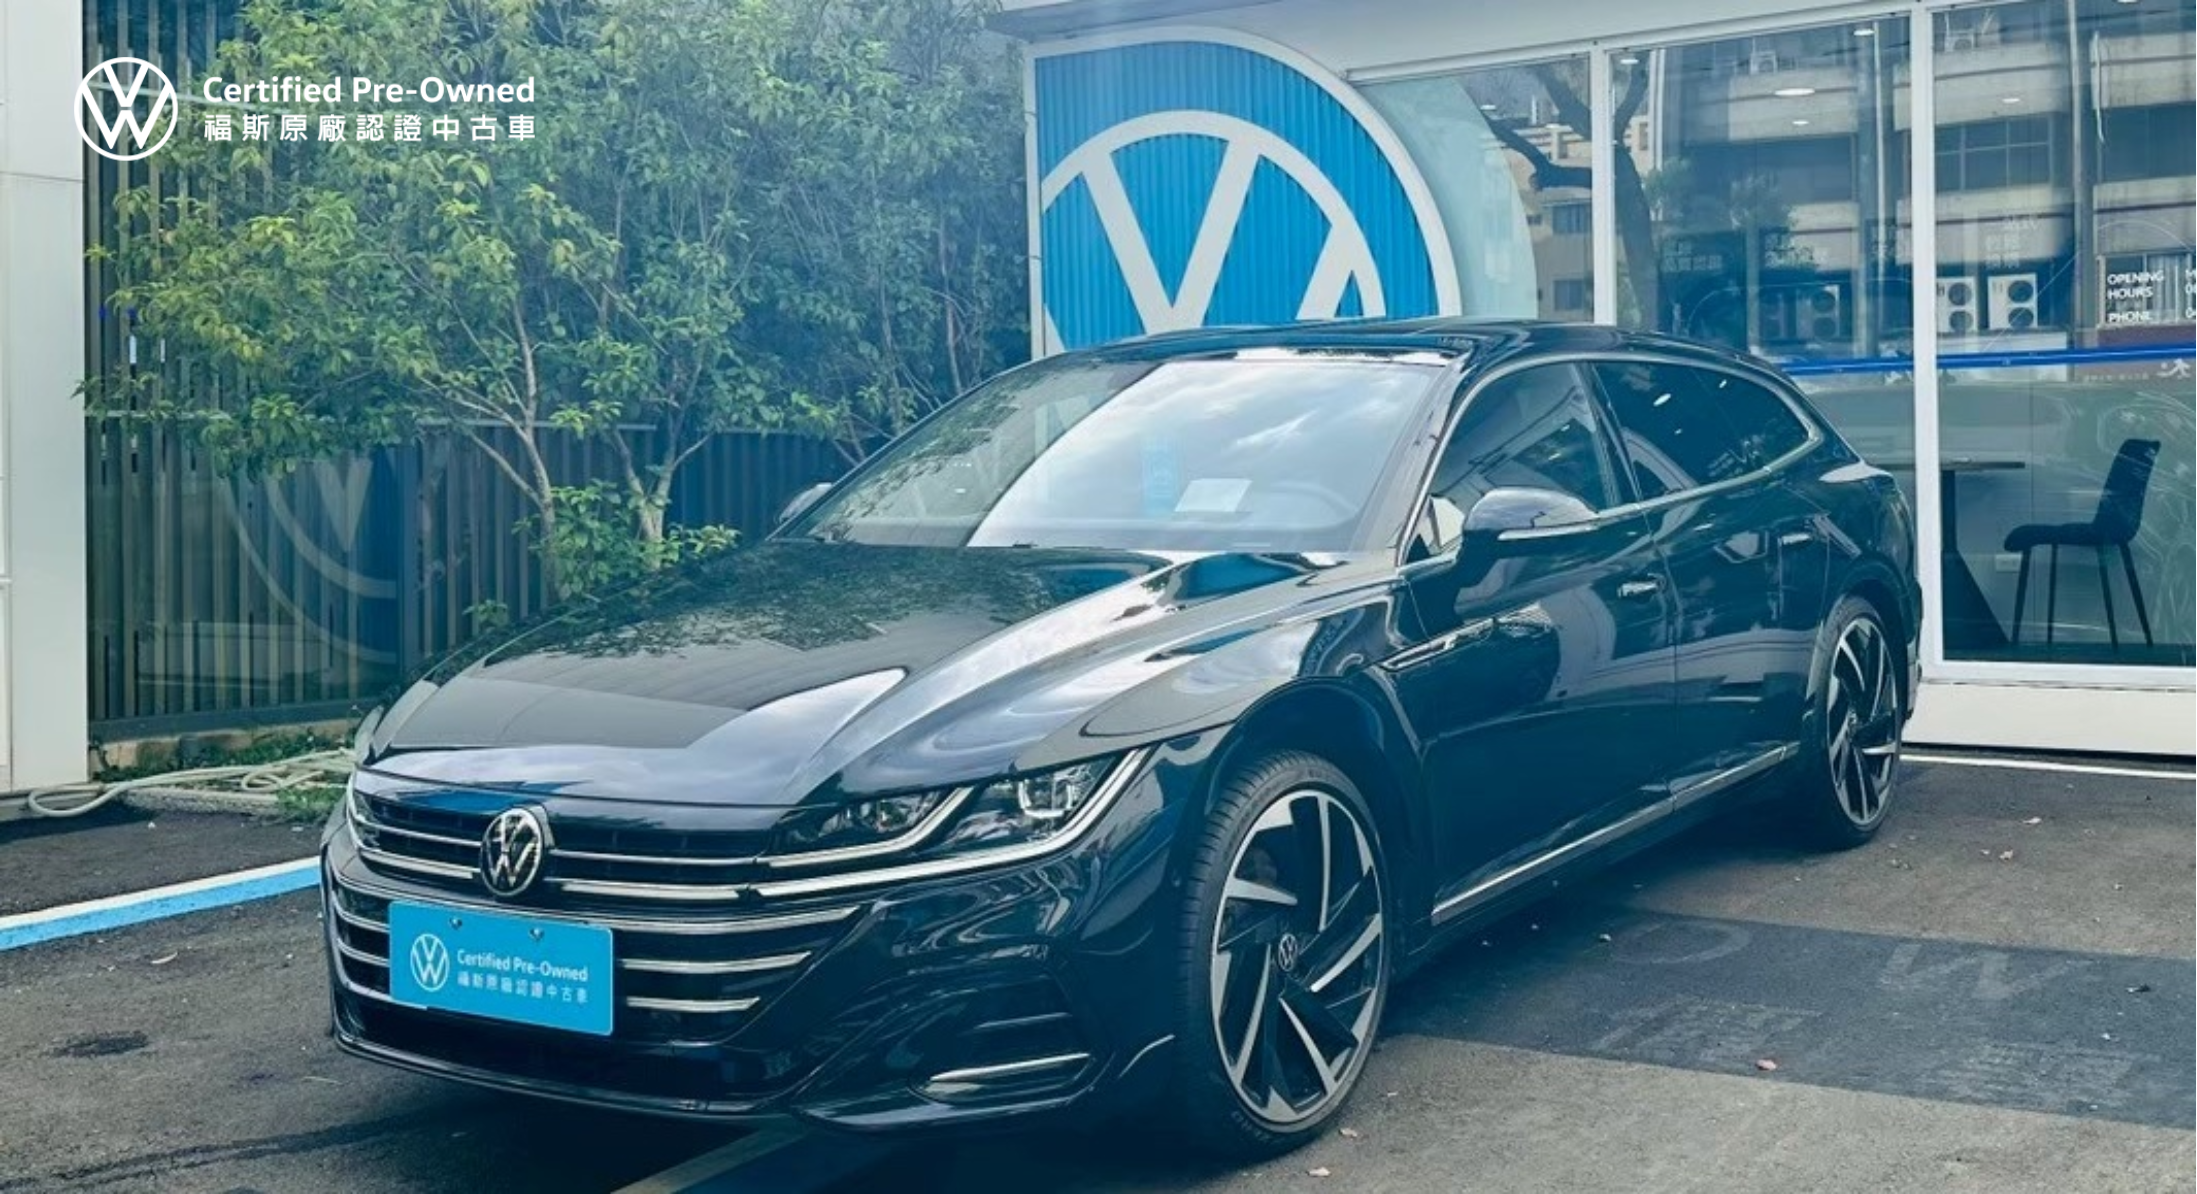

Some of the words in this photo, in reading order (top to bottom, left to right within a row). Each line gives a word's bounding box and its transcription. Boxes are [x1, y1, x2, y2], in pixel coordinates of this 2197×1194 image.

[2107, 270, 2164, 285] OPENING
[2107, 286, 2153, 300] HOURS
[457, 950, 510, 971] Certified
[513, 956, 588, 982] Pre-Owned
